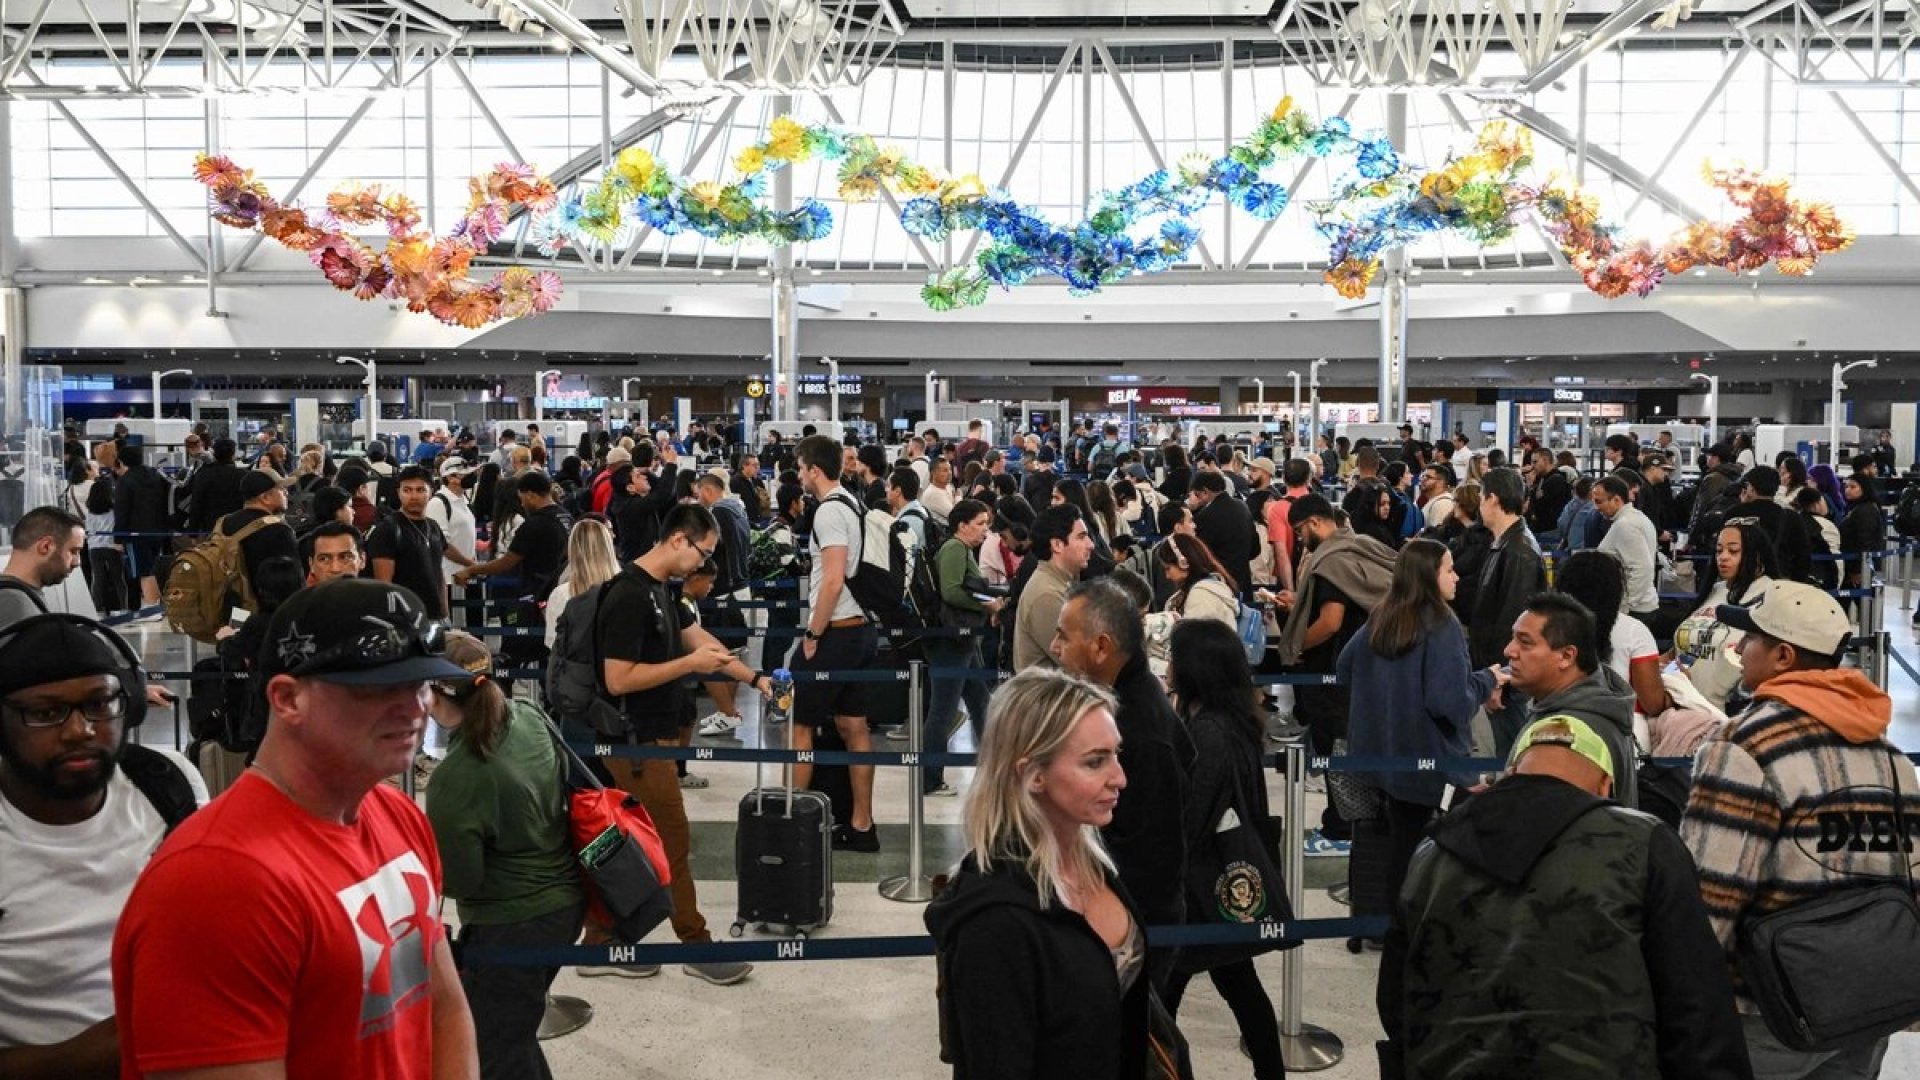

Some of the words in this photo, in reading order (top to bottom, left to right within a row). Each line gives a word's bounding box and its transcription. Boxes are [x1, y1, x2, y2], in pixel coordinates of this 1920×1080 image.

[495, 668, 510, 678] IAH
[815, 671, 830, 681] IAH
[895, 671, 910, 680] IAH
[1322, 674, 1337, 685] IAH
[594, 744, 612, 756] IAH
[696, 748, 713, 760] IAH
[797, 751, 814, 764] IAH
[901, 753, 919, 764] IAH
[1311, 757, 1330, 769] IAH
[1417, 758, 1436, 771] IAH
[1260, 922, 1285, 939] IAH
[609, 946, 636, 962] IAH
[776, 941, 804, 958] IAH
